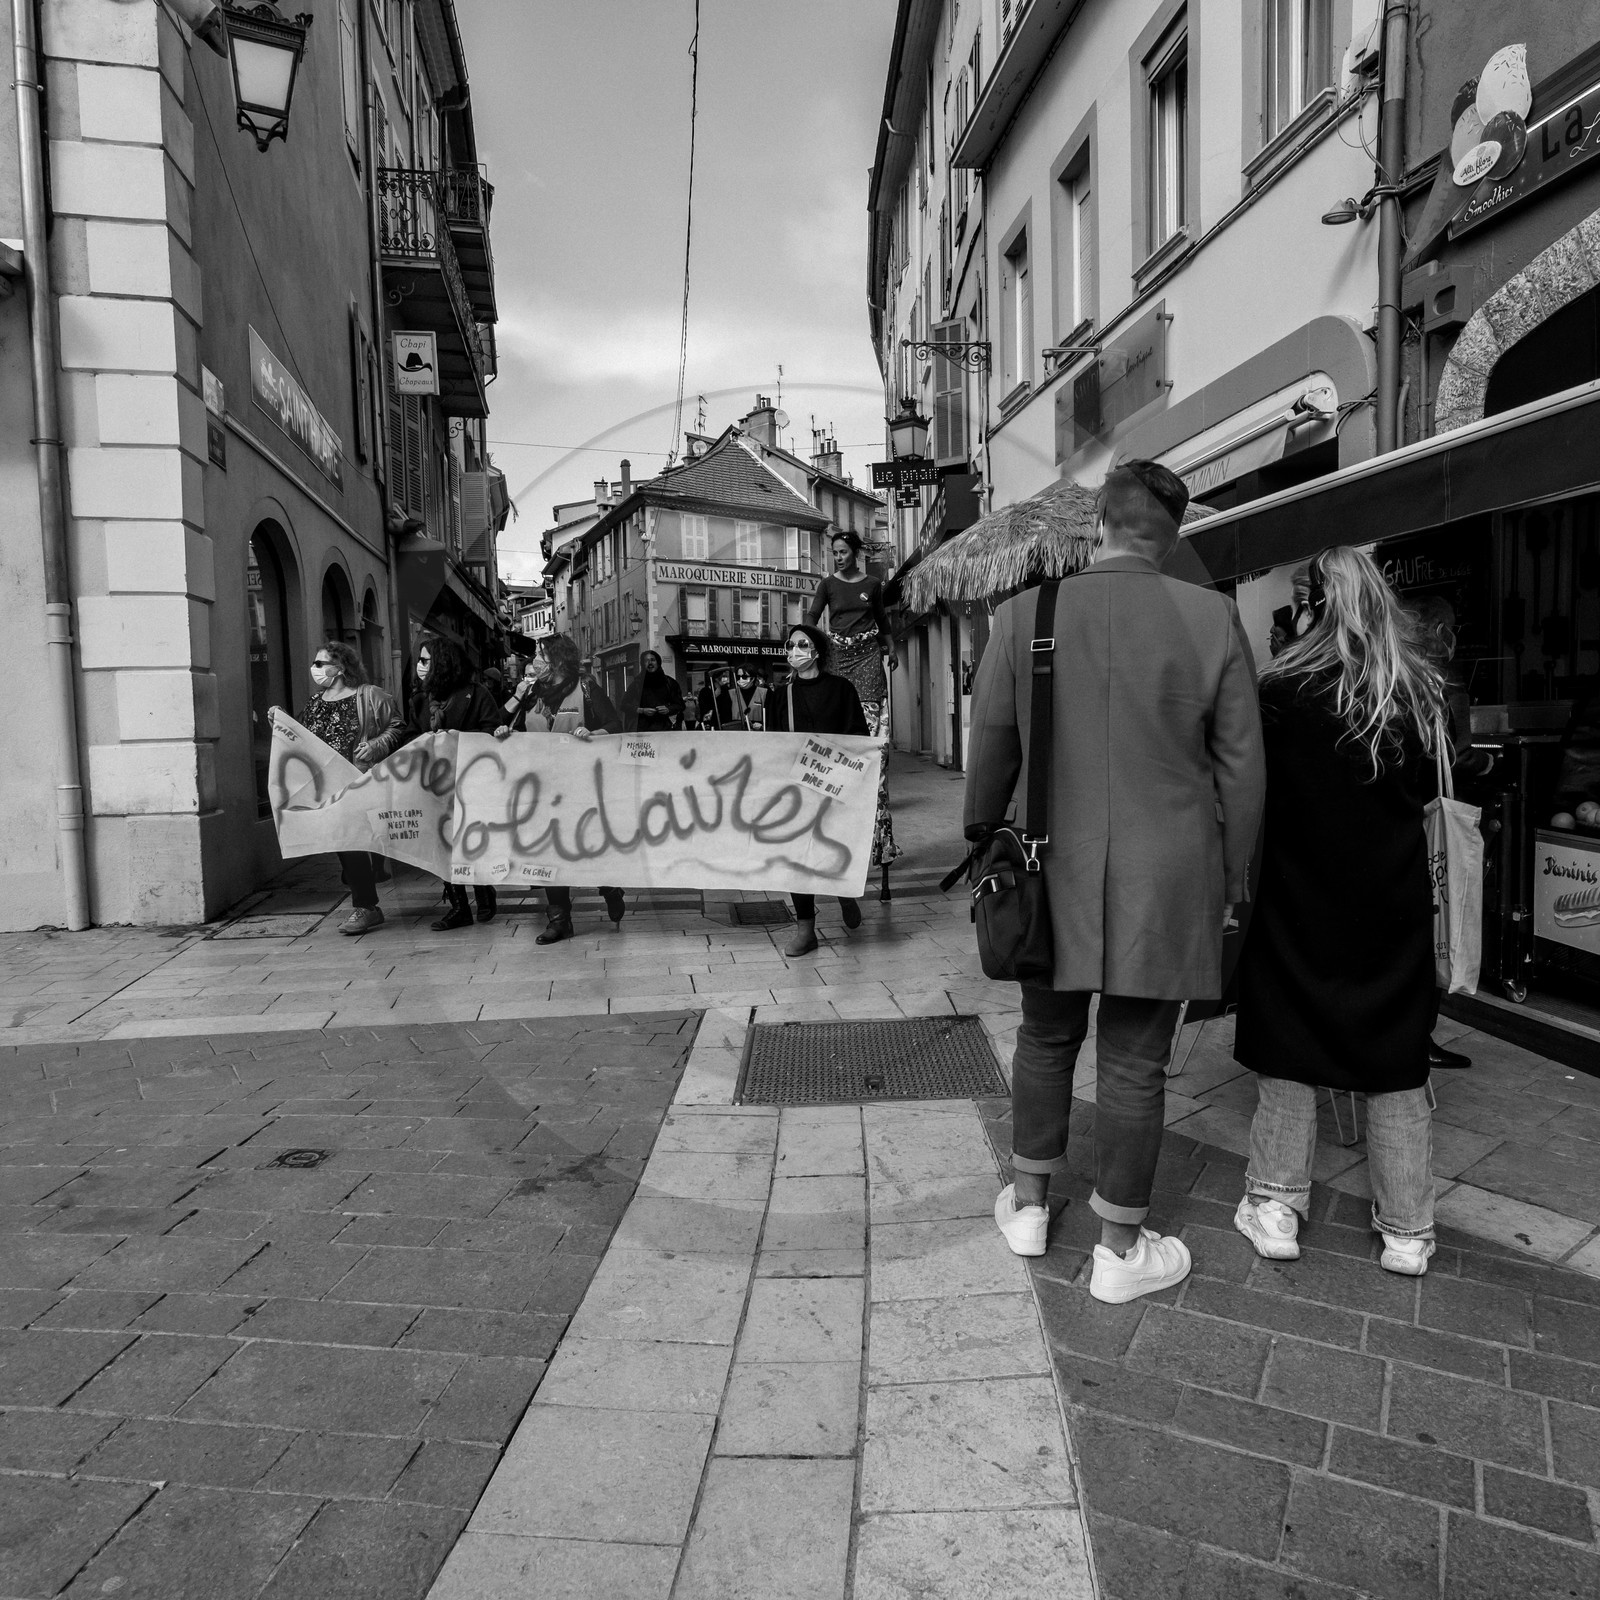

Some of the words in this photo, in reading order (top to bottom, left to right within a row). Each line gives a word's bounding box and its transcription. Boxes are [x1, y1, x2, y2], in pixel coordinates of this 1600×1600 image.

[1542, 105, 1582, 162] La
[400, 338, 427, 350] Chapi
[399, 377, 433, 386] Chapeaux
[279, 377, 308, 444] SAINT
[659, 565, 747, 584] MAROQUINERIE
[750, 572, 793, 589] SELLERIE
[796, 577, 807, 590] DU
[1383, 556, 1436, 587] GAUFRE
[701, 645, 759, 655] MAROQUINERIE
[274, 725, 298, 742] MARS
[806, 739, 833, 759] POUR
[809, 759, 833, 775] FAUT
[378, 810, 402, 820] NOTRE
[404, 809, 423, 818] CORPS
[387, 820, 405, 829] N'EST
[407, 820, 419, 828] PAS
[389, 832, 399, 840] UN
[400, 830, 420, 840] OBJET
[453, 866, 471, 876] MARS
[1543, 856, 1599, 886] Paninis
